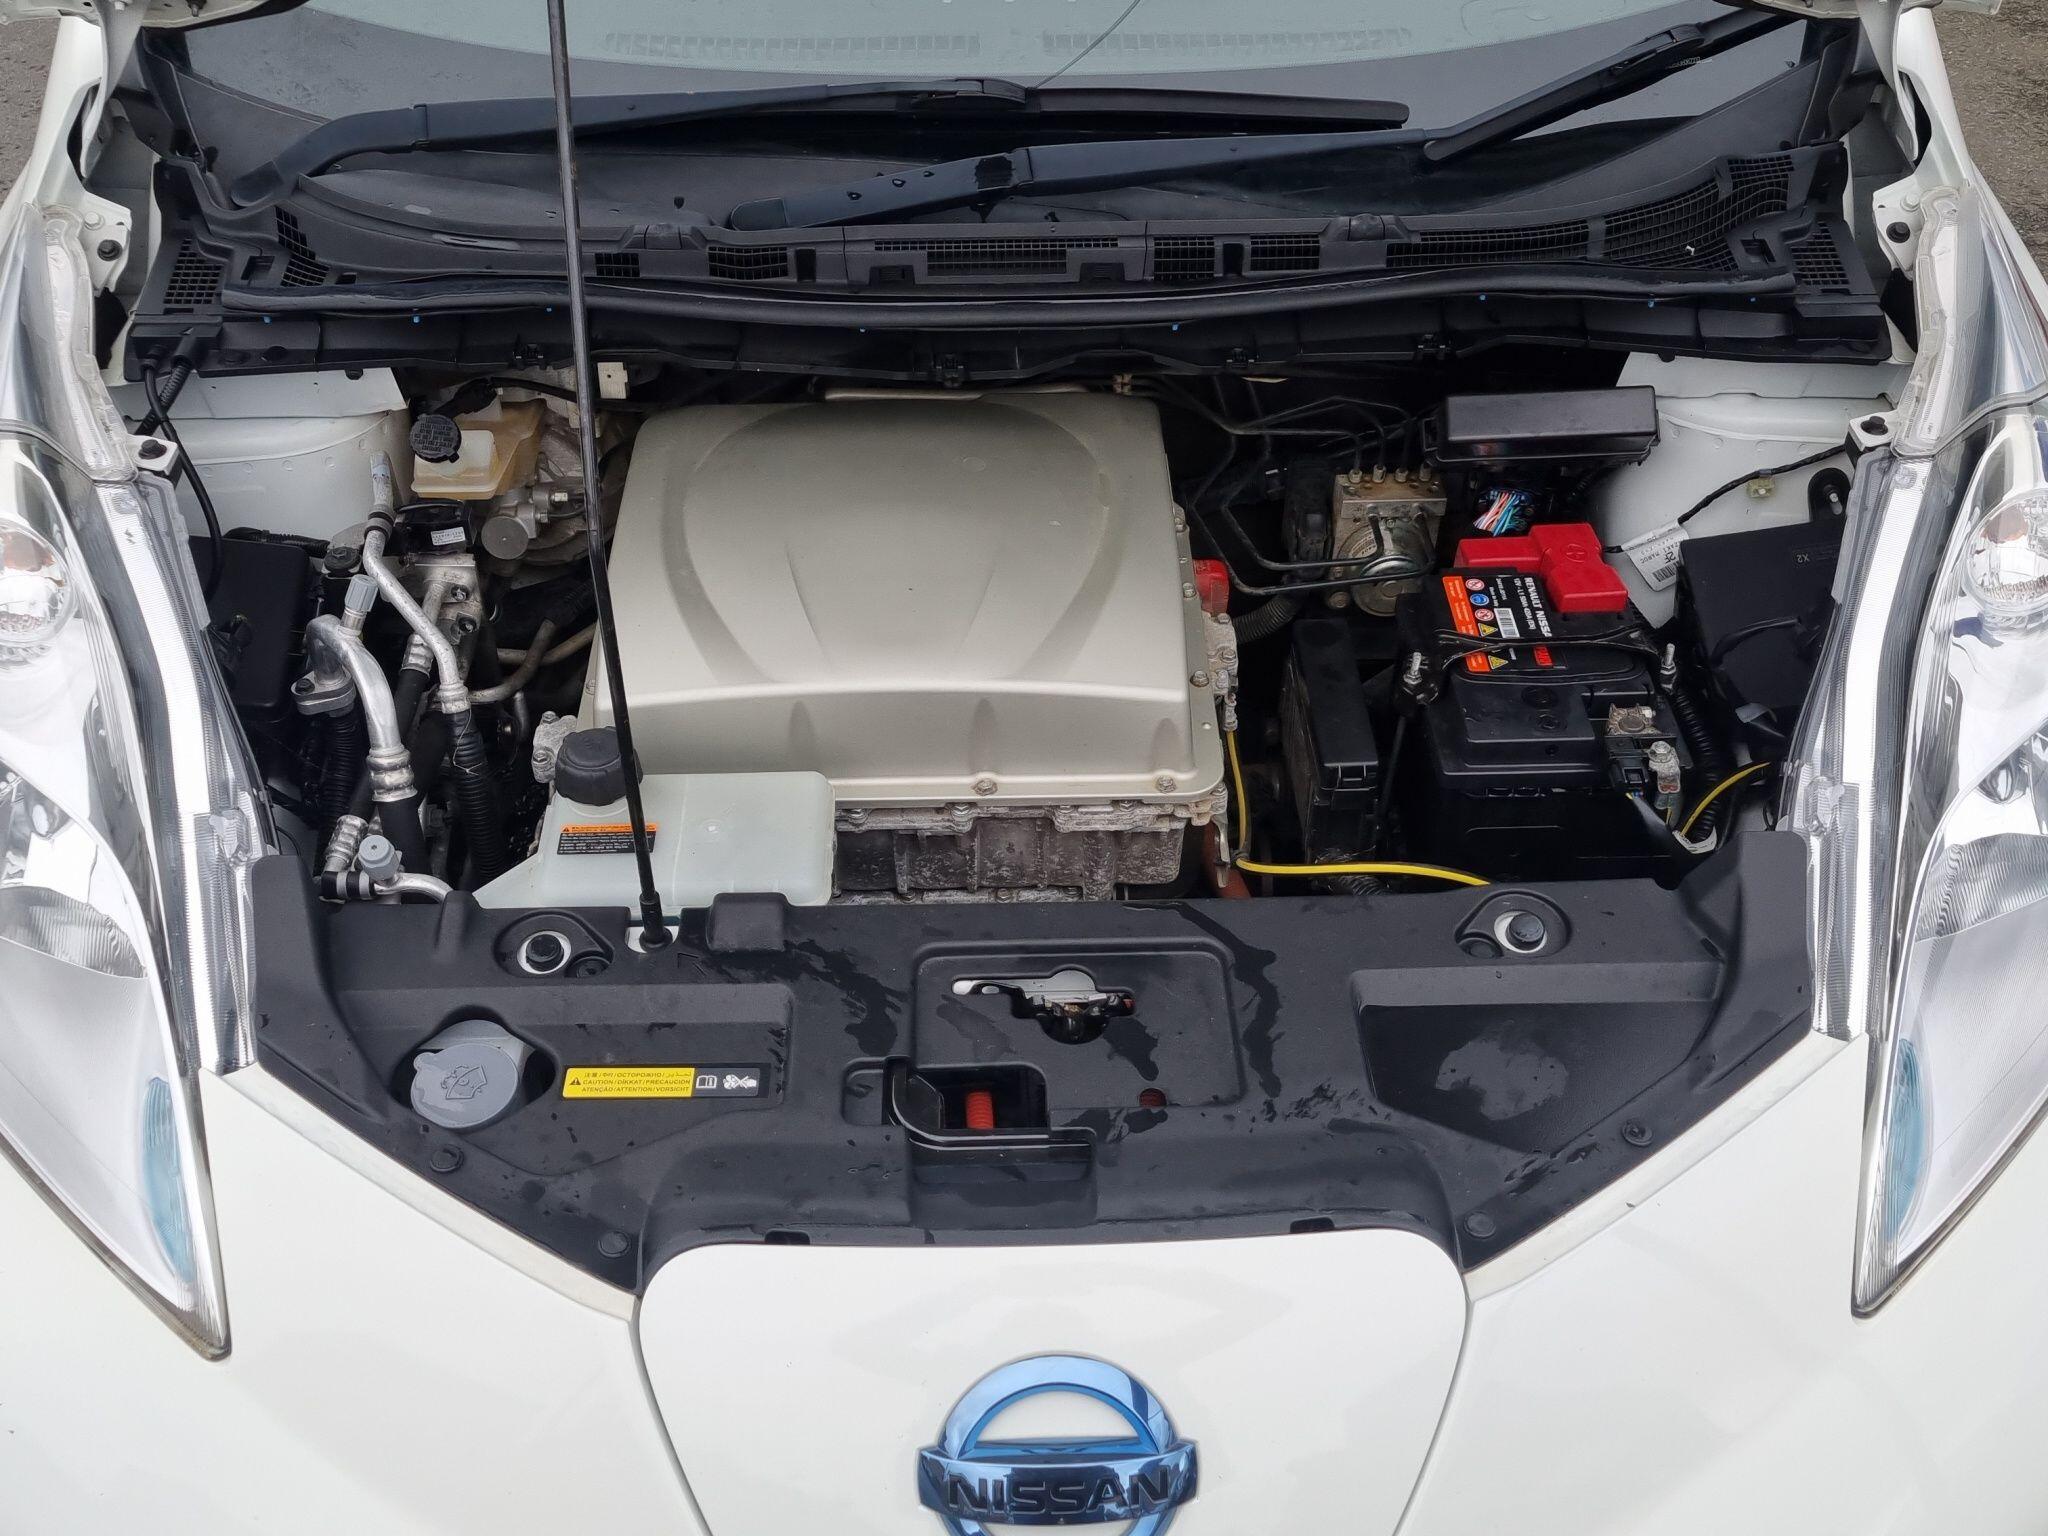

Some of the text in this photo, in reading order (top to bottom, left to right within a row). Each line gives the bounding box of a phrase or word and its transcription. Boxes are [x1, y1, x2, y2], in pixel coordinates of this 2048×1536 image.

[1524, 577, 1542, 608] RENAULT
[1535, 611, 1552, 637] NISSA
[948, 1466, 1170, 1515] NISSAN
